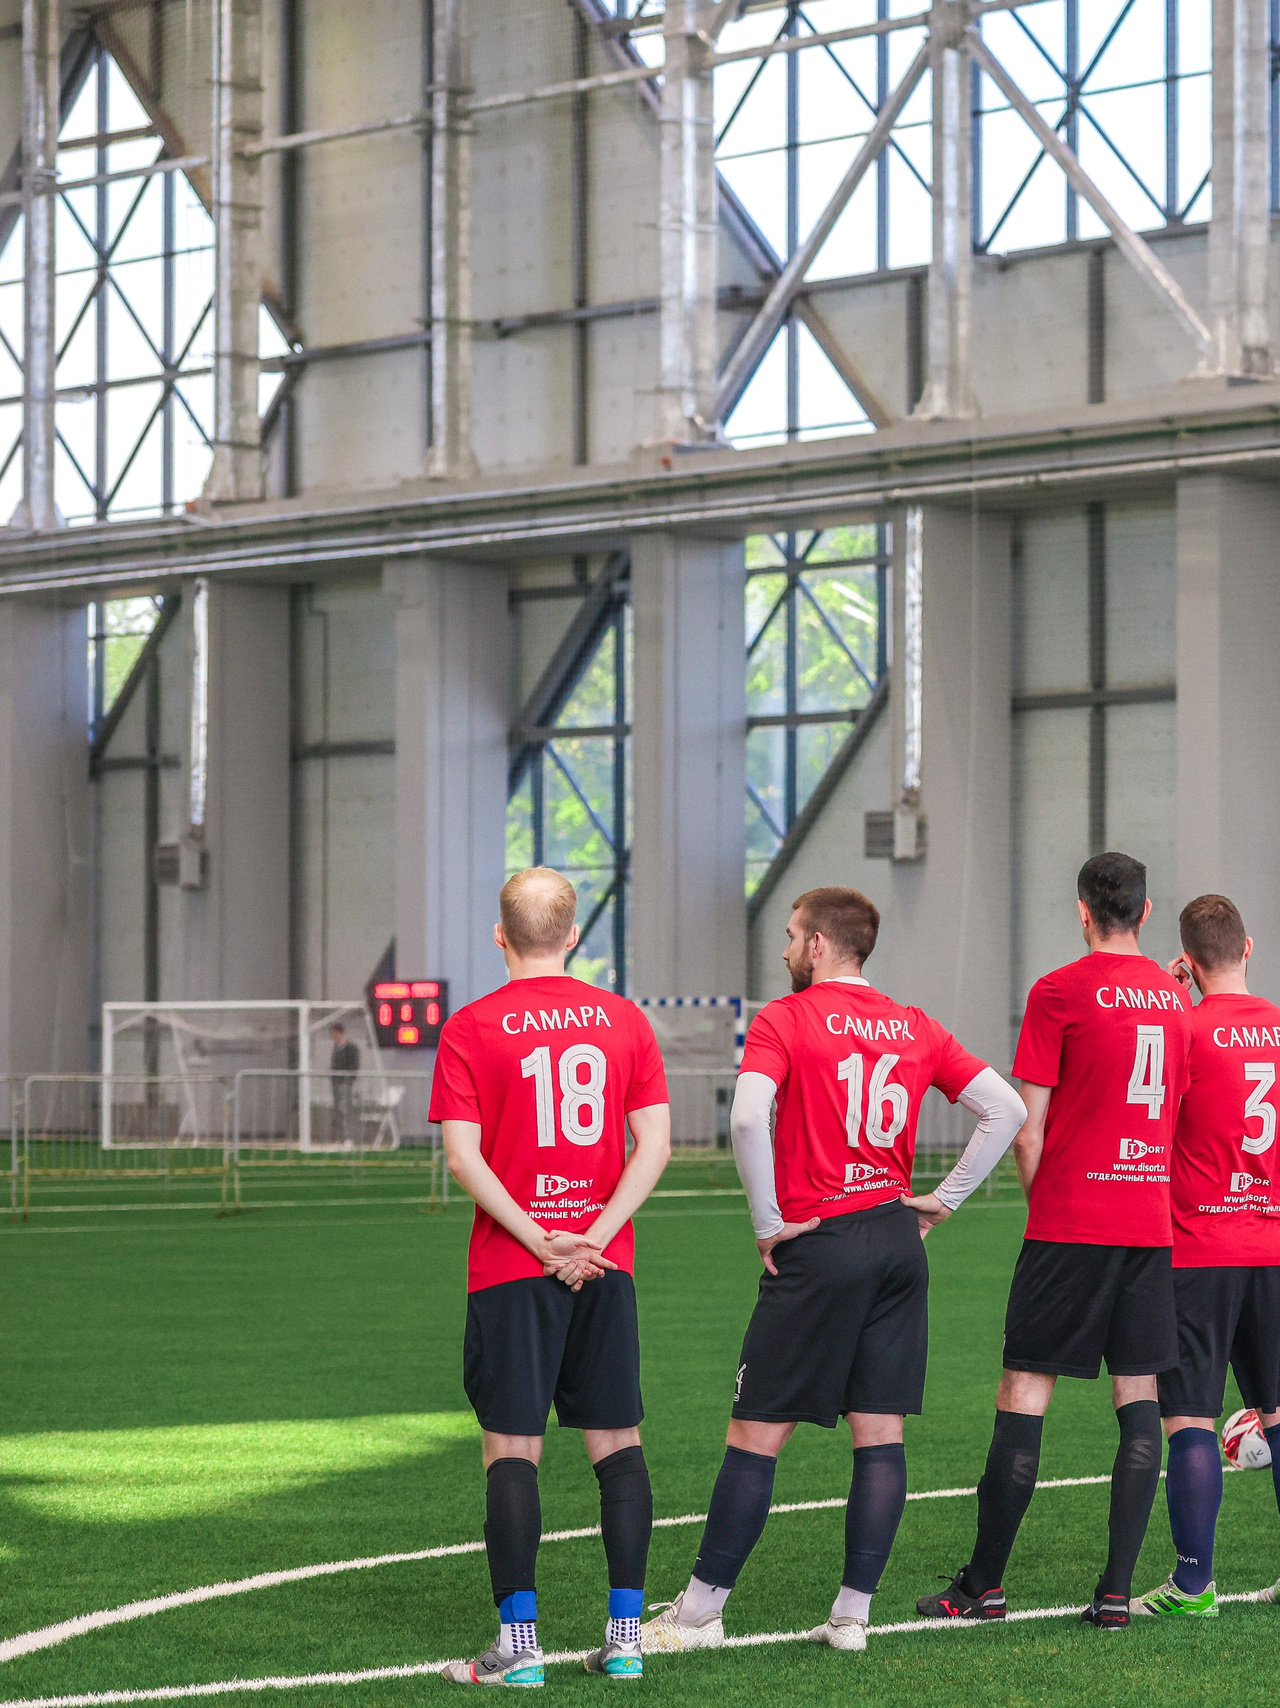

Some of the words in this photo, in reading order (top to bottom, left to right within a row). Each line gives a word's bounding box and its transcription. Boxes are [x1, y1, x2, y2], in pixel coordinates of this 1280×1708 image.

[1096, 986, 1185, 1013] САМАРА
[502, 1006, 612, 1035] САМАРА
[825, 1013, 916, 1041] САМАРА
[1126, 1024, 1167, 1120] 4
[520, 1043, 608, 1148] 18
[837, 1052, 909, 1148] 16
[1241, 1062, 1277, 1155] 3
[1086, 1172, 1145, 1182] ОТДЕЛОЧНЫЕ
[1230, 1172, 1271, 1192] DISOR
